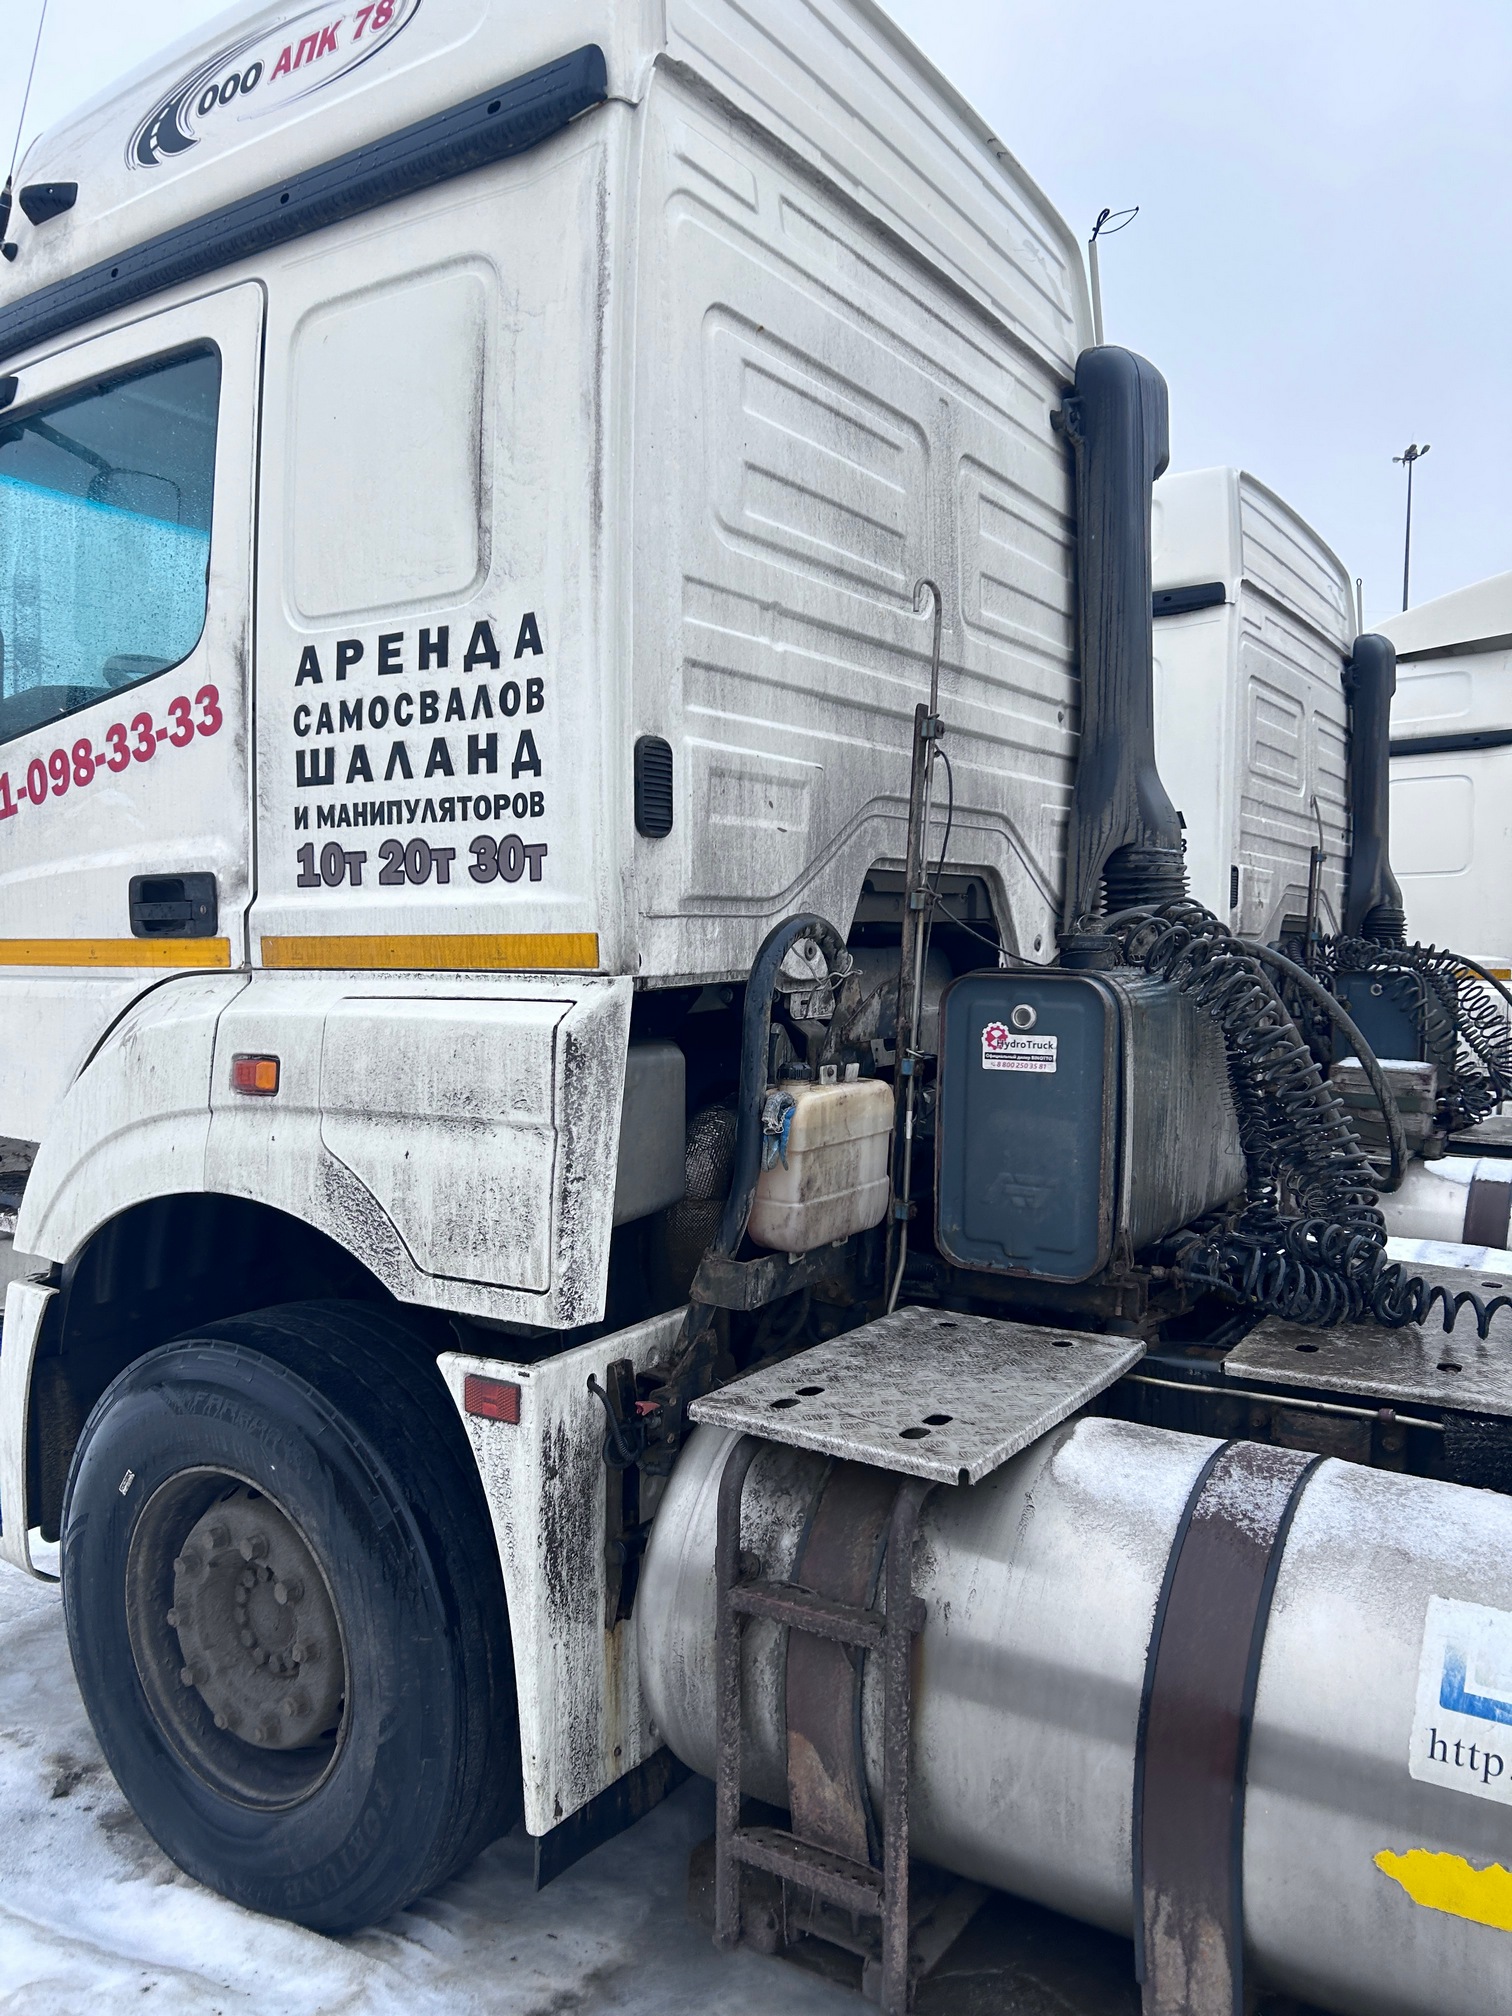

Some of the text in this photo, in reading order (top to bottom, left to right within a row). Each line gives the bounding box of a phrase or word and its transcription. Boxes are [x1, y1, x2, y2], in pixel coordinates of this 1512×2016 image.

[197, 0, 396, 116] ООО АПК 78
[294, 611, 544, 687] АРЕНДА
[293, 676, 545, 737] САМОСВАЛОВ
[296, 729, 542, 788] ШАЛАНД
[294, 791, 545, 830] И МАНИПУЛЯТОРОВ
[996, 1039, 1054, 1050] HydroTruck
[1427, 1727, 1512, 1785] http
